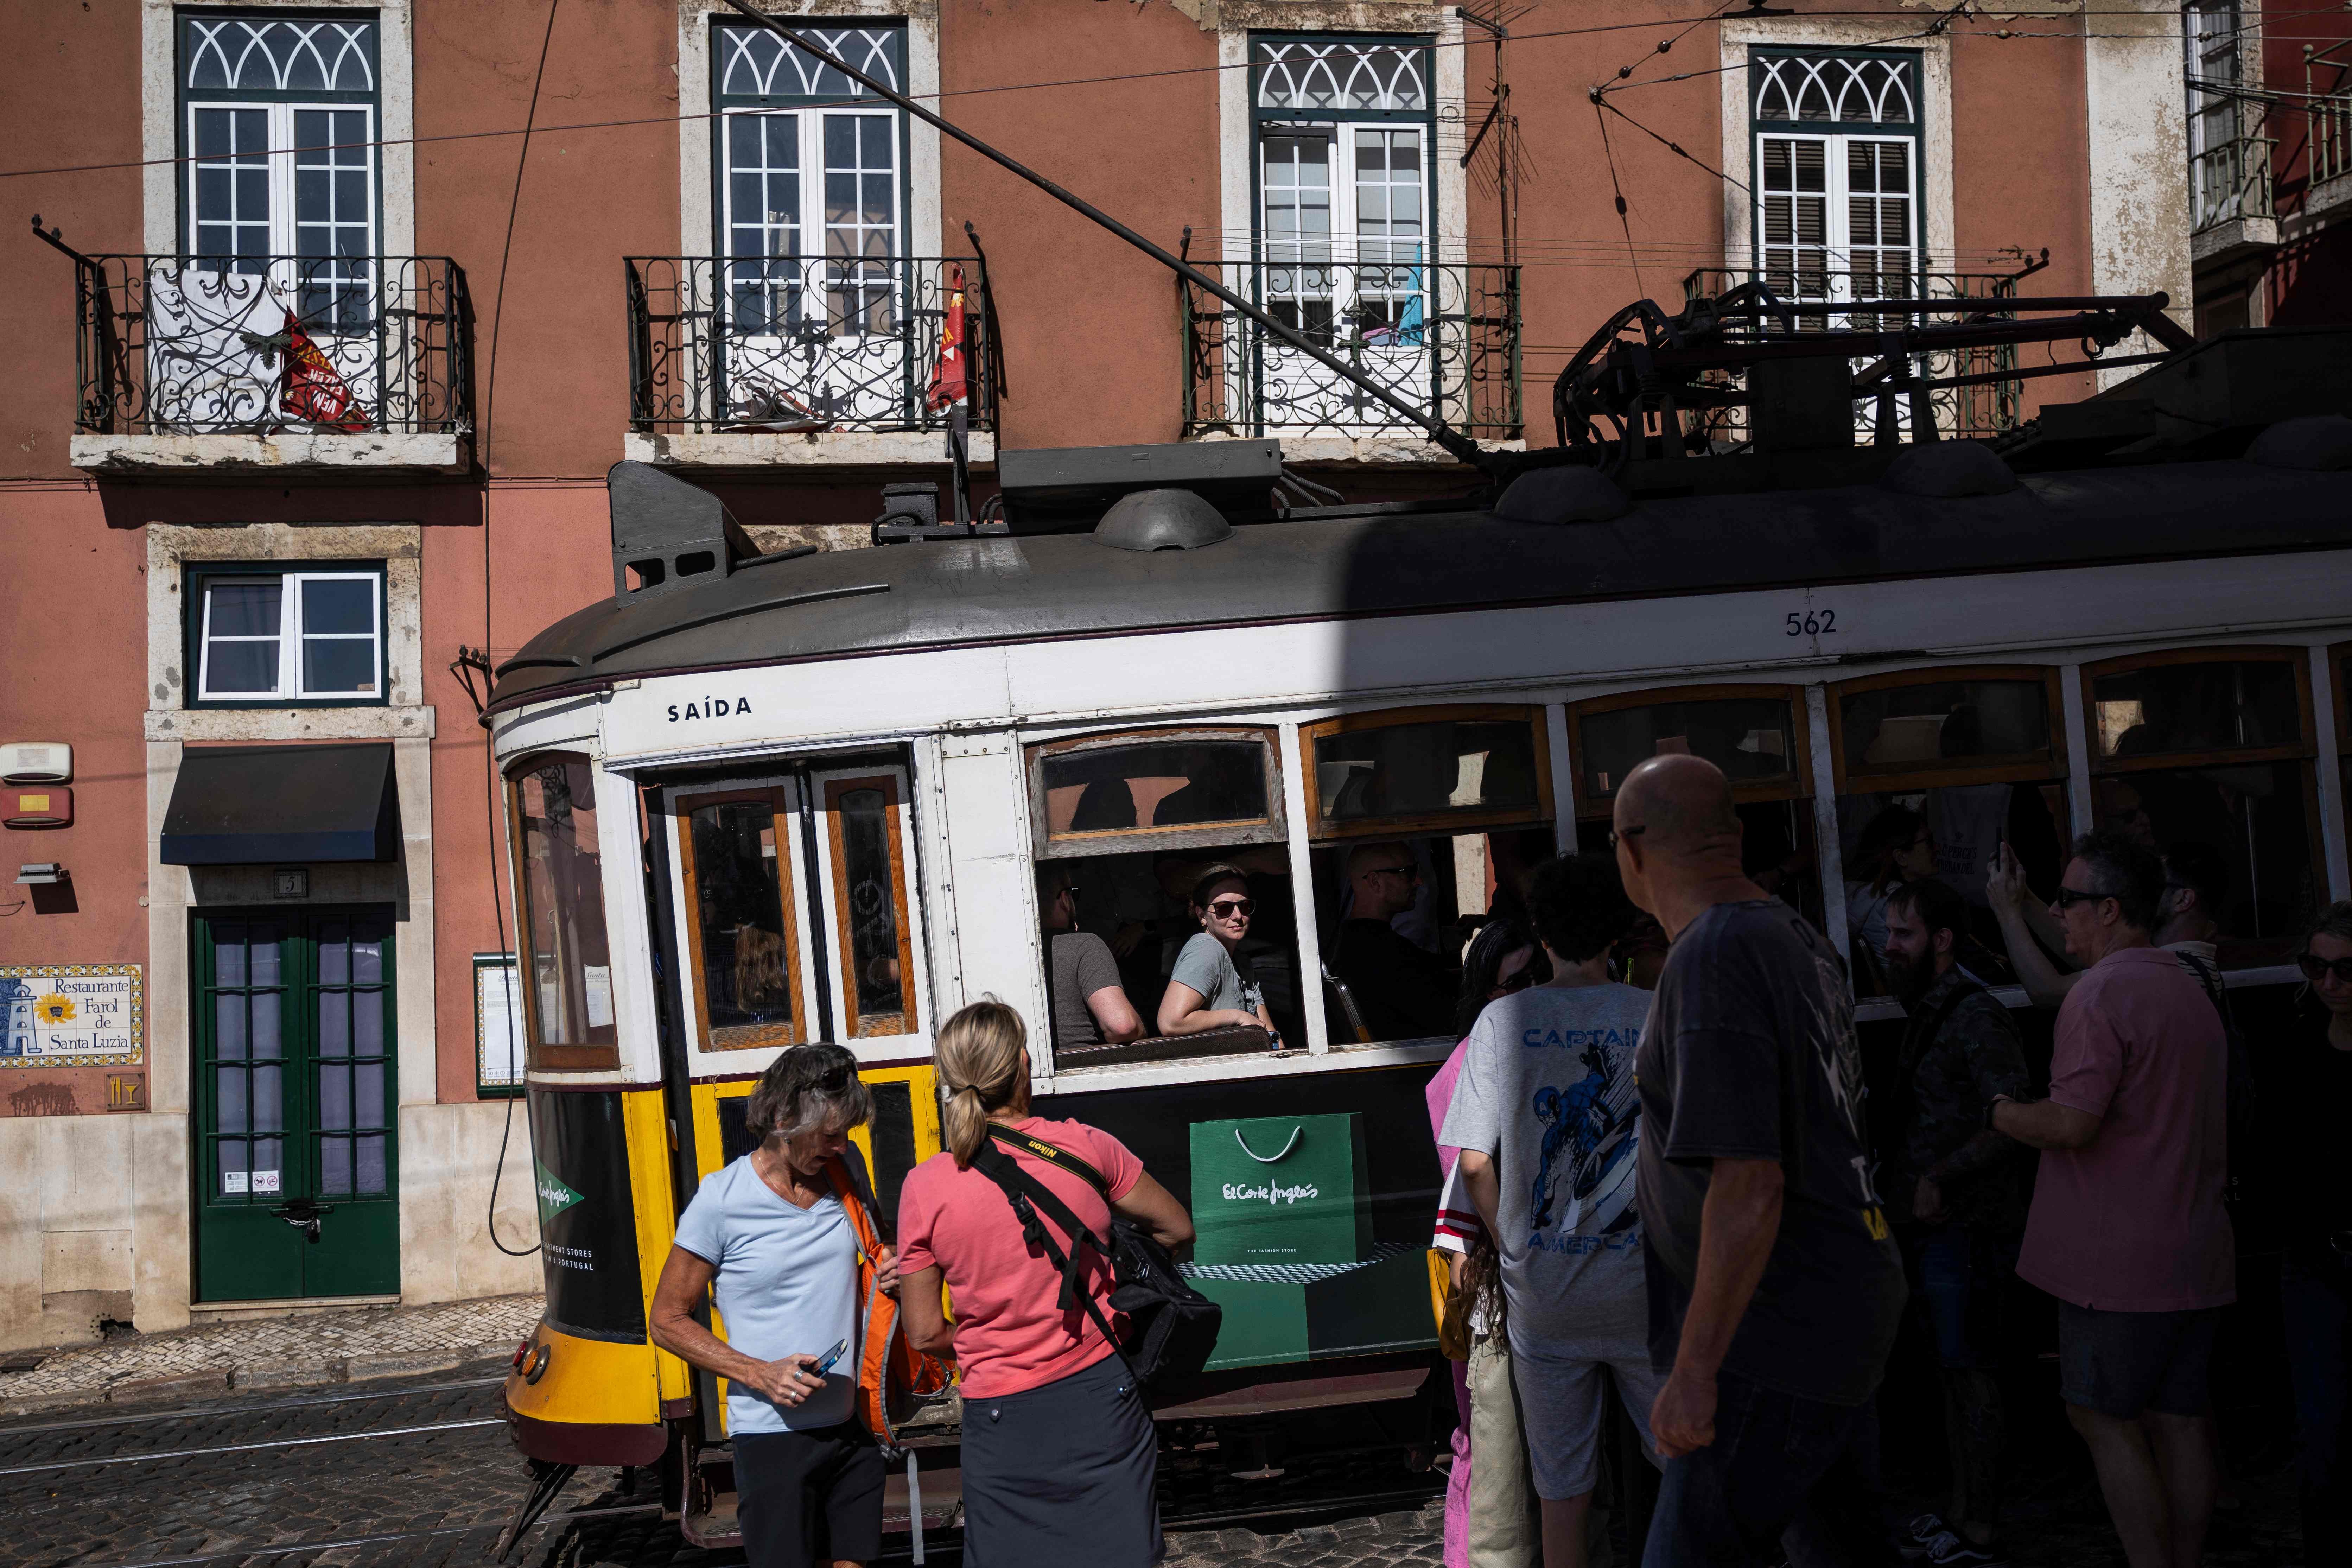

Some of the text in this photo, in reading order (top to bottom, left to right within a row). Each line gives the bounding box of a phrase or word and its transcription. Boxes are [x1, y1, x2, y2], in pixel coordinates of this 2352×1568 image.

[1787, 609, 1836, 636] 562
[668, 695, 752, 722] SAÍDA
[286, 876, 295, 892] 5
[55, 978, 129, 994] Restaurante
[84, 998, 118, 1014] Farol
[95, 1015, 111, 1029] de
[50, 1033, 129, 1051] Santa Luzia
[1028, 1141, 1057, 1158] Nikon
[549, 1180, 570, 1207] Inglés
[1222, 1179, 1318, 1205] El Corte Inglés
[1528, 1232, 1640, 1255] AMERCA
[567, 1248, 592, 1258] STORES
[558, 1258, 593, 1270] PORTUGAL
